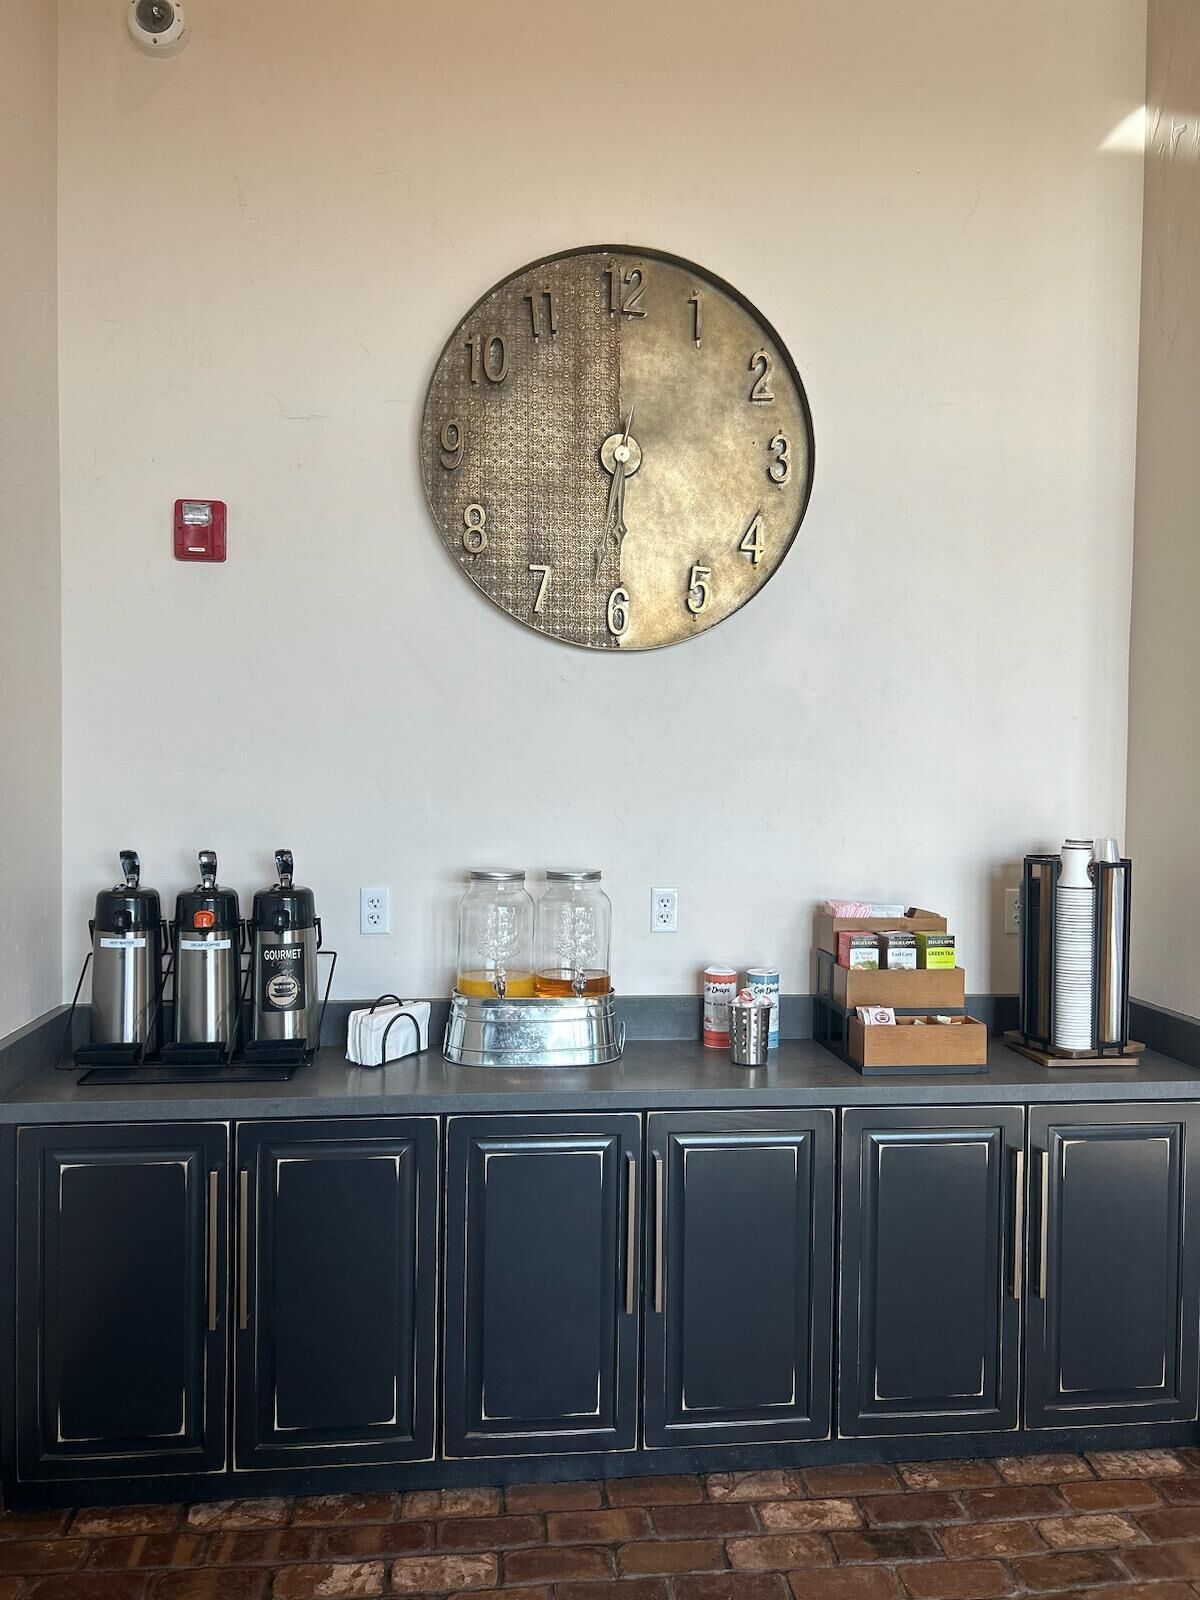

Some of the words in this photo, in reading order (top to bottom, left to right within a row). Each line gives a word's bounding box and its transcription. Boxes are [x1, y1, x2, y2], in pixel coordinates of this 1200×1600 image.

[524, 288, 559, 338] 11
[603, 260, 647, 318] 12
[689, 290, 704, 343] 1
[466, 335, 510, 384] 10
[749, 350, 774, 401] 2
[440, 418, 465, 470] 9
[768, 433, 792, 484] 3
[463, 503, 487, 554] 8
[740, 514, 766, 564] 4
[529, 564, 552, 613] 7
[606, 587, 630, 636] 6
[688, 565, 713, 615] 5
[263, 949, 301, 960] GOURMET
